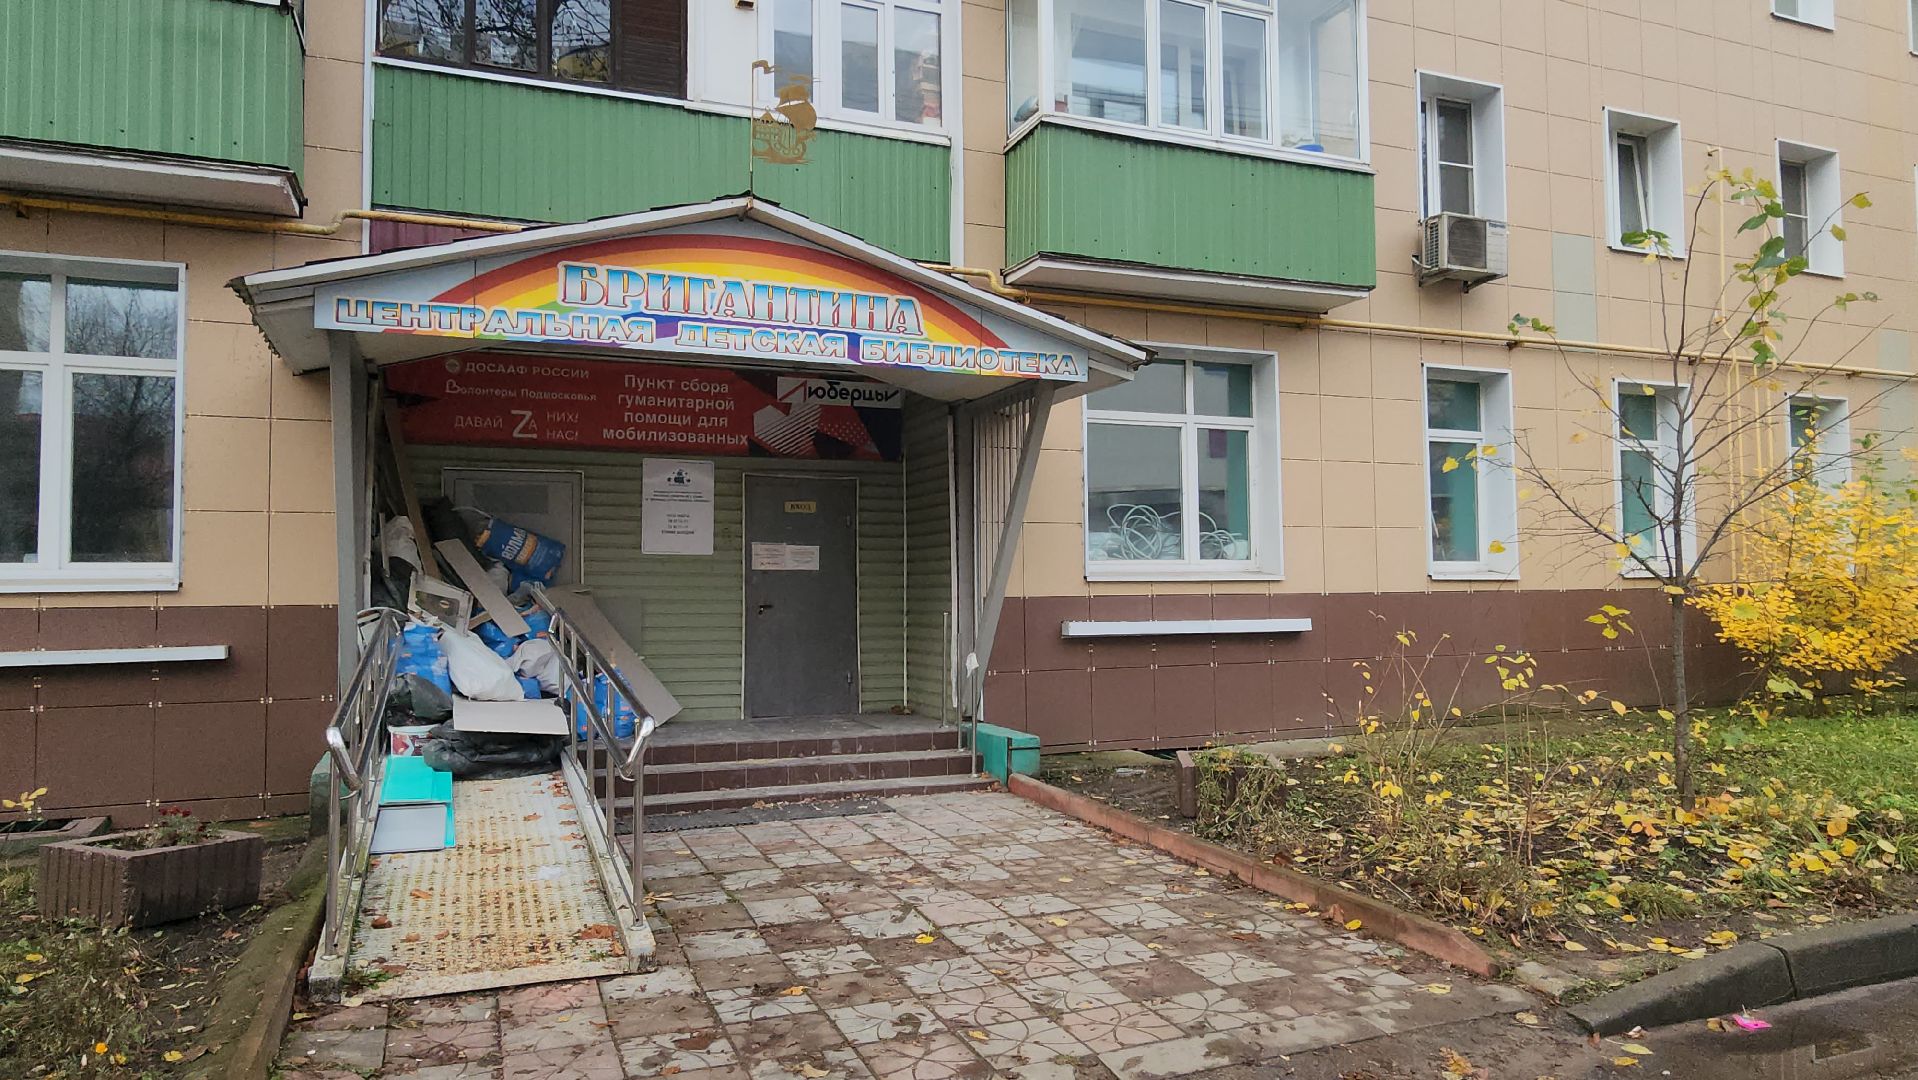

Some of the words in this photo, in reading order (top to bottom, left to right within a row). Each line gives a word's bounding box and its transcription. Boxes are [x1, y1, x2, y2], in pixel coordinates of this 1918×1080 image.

[562, 264, 923, 335] БРИГАНТИНА
[336, 297, 653, 343] ЦЕНТРАЛЬНАЯ
[676, 323, 845, 358] ДЕТСКАЯ
[862, 339, 1079, 376] БИБЛИОТЕКА
[465, 362, 528, 375] ДОСААФ
[532, 366, 590, 379] РОССИИ
[446, 379, 517, 398] Волонтеры
[520, 389, 597, 401] Подмосковья
[624, 374, 675, 391] Пункт
[681, 378, 729, 394] сбора
[618, 394, 735, 411] гуманитарной
[454, 414, 503, 429] ДАВАЙ
[624, 411, 692, 427] помощи
[697, 413, 728, 429] для
[546, 429, 579, 441] НАС!
[602, 428, 749, 446] мобилизованных
